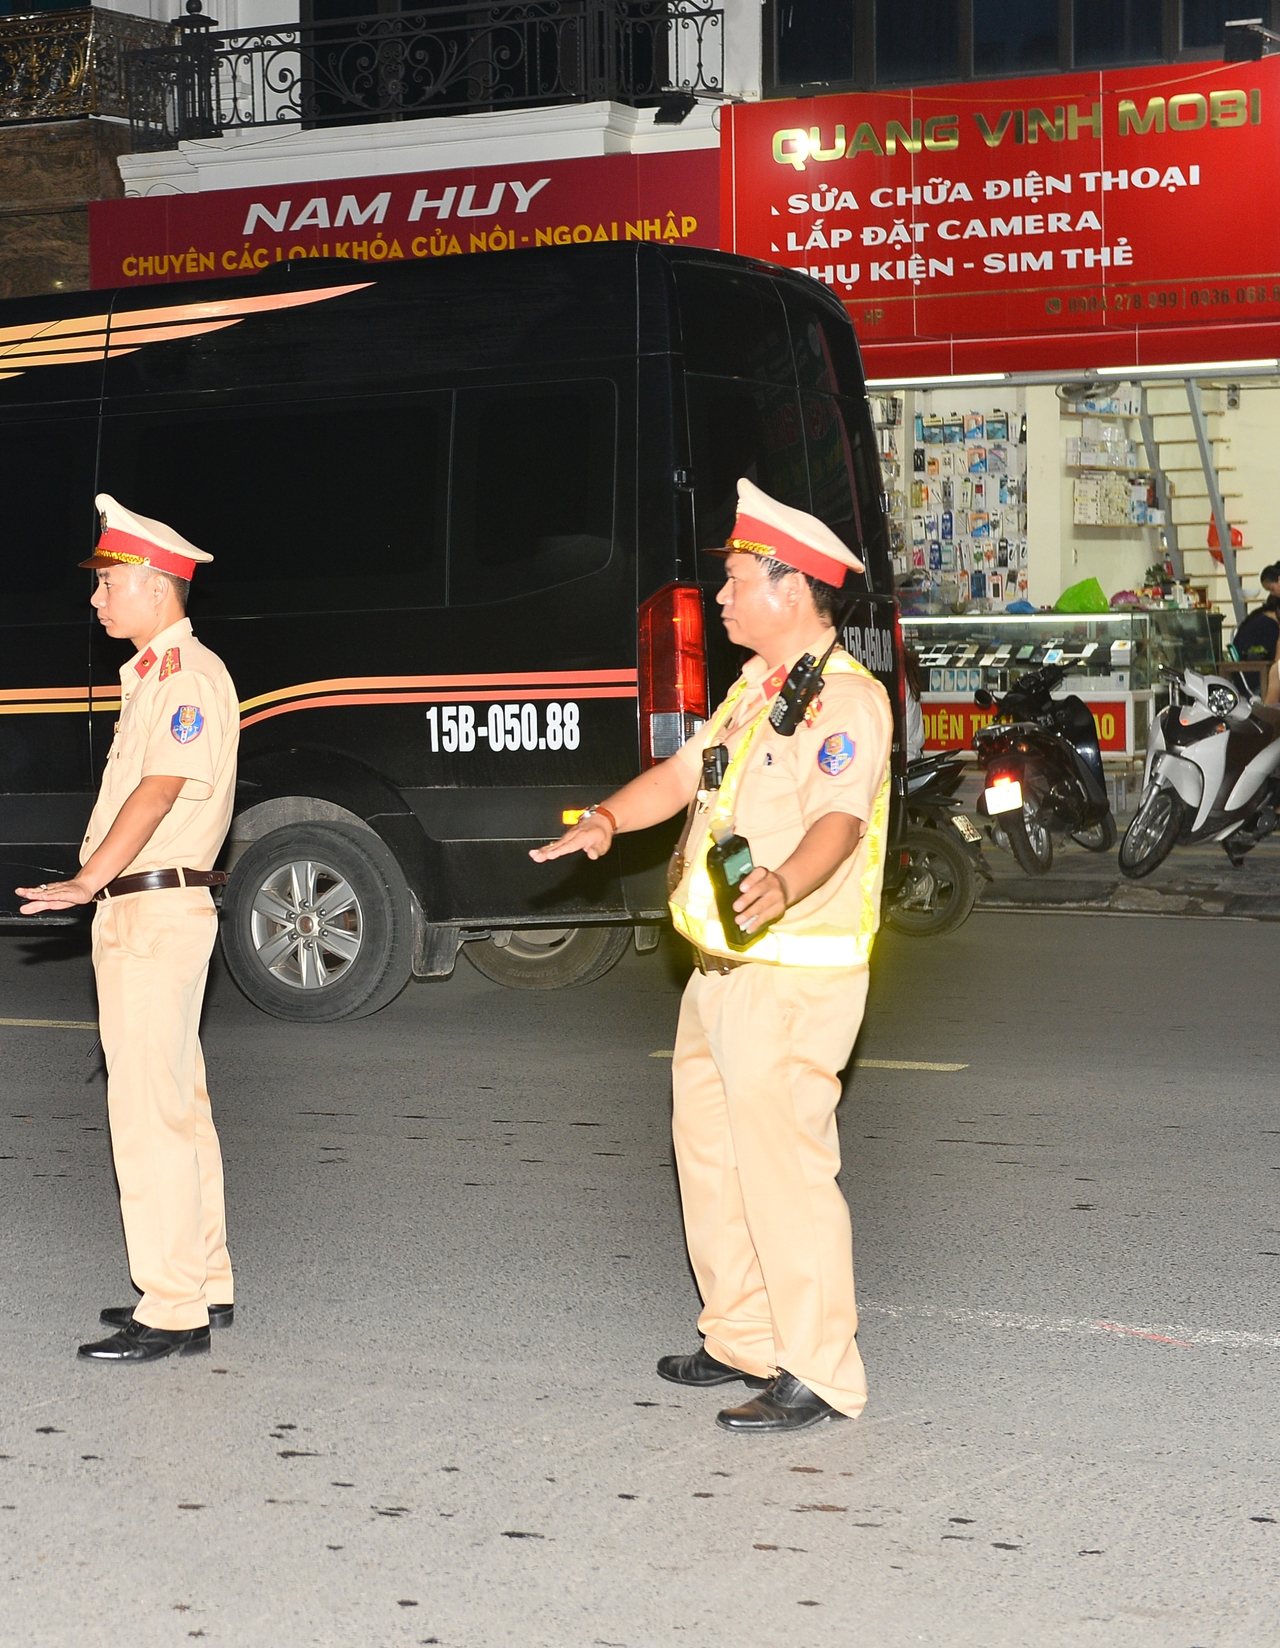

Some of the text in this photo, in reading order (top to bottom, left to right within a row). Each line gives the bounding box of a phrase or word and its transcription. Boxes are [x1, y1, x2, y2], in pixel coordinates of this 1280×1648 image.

[772, 88, 1261, 171] QUANG VINH MOBI
[242, 178, 551, 235] NAM HUY
[787, 164, 1200, 214] SỬA CHỮA ĐIỆN THOẠI
[122, 246, 215, 276] CHUYÊN
[222, 243, 269, 270] CÁC
[335, 232, 404, 261] KHÓA
[412, 229, 462, 257] CỬA
[625, 210, 698, 245] NHẬP
[787, 209, 1102, 252] LẮP ĐẶT CAMERA
[870, 252, 954, 286] KIỆN
[983, 250, 1054, 274] SIM
[1061, 237, 1133, 269] THẺ
[863, 308, 885, 326] HP
[1068, 290, 1178, 314] 0904.278.999
[425, 702, 581, 753] 15B-050.88
